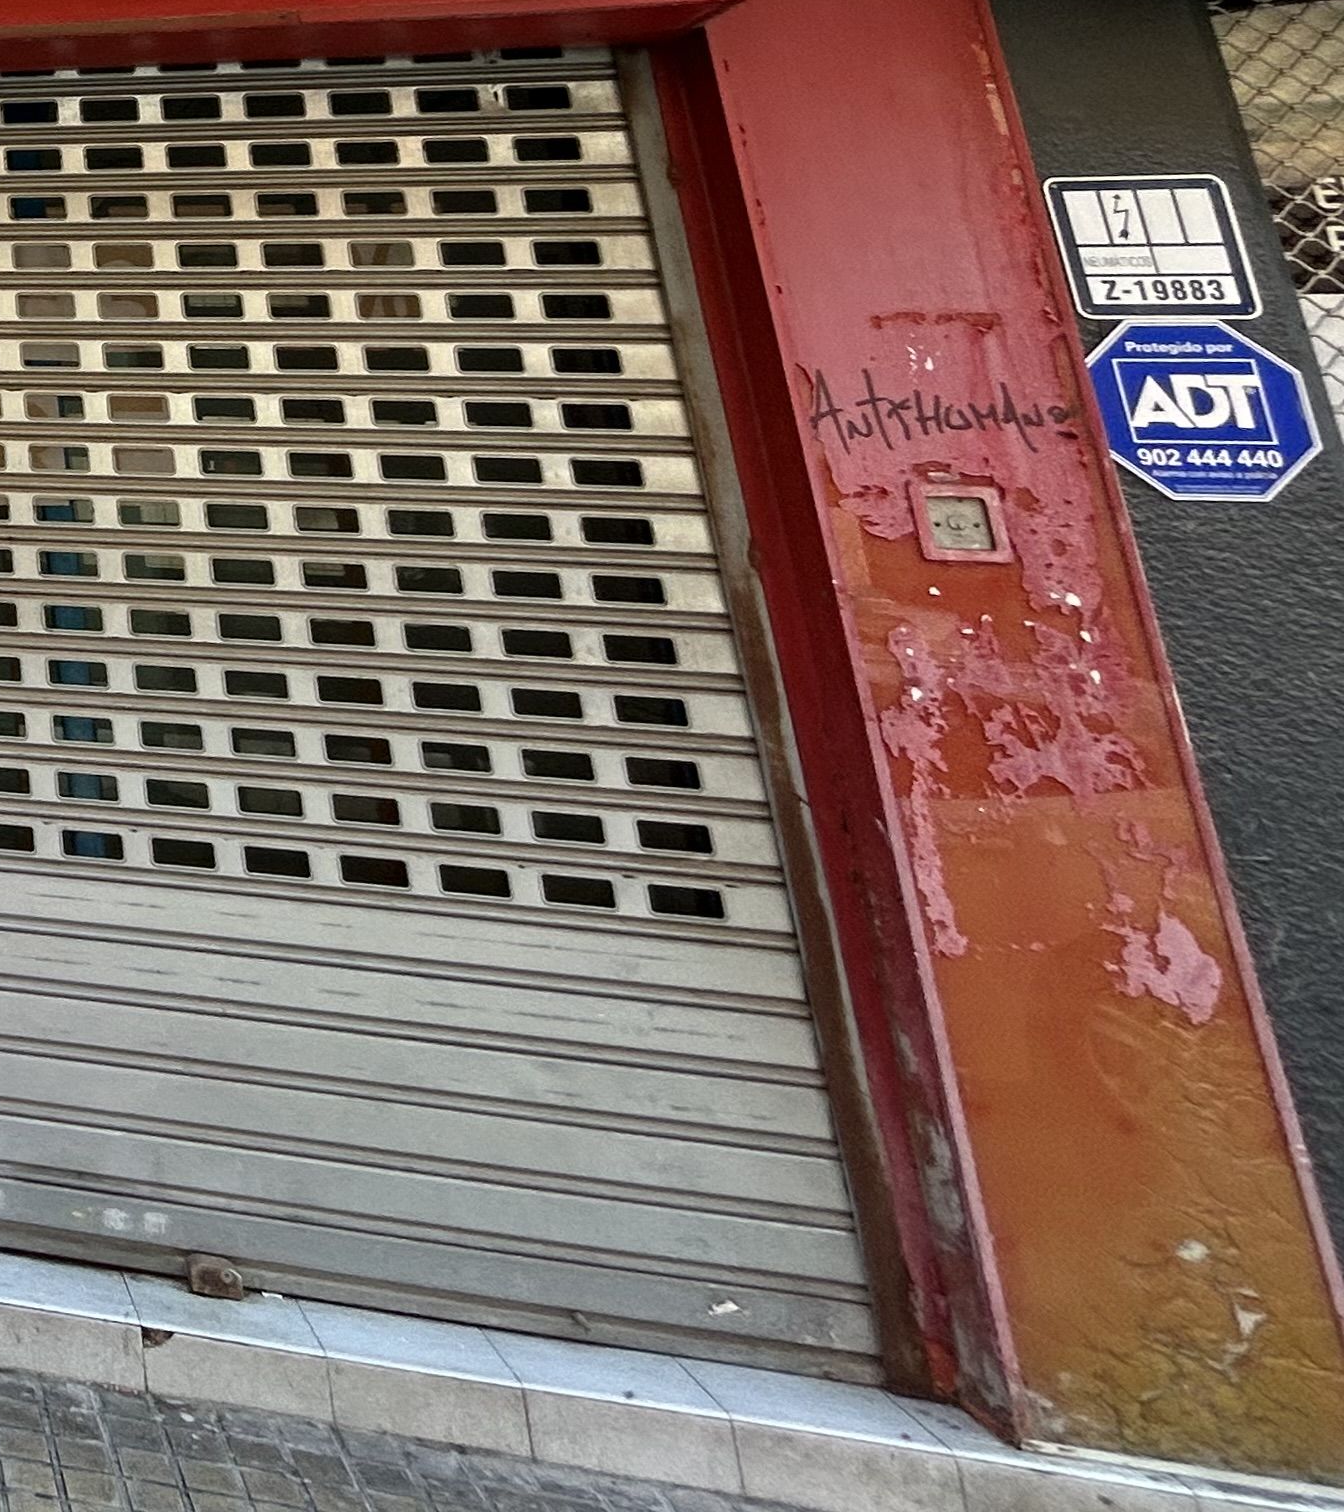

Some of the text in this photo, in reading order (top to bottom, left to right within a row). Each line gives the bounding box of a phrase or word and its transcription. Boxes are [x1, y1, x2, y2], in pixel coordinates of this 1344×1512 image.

[1100, 279, 1225, 301] Z-19883
[1124, 341, 1234, 355] Protegido por
[1131, 374, 1261, 429] ADT
[1137, 448, 1284, 468] 902 444 440
